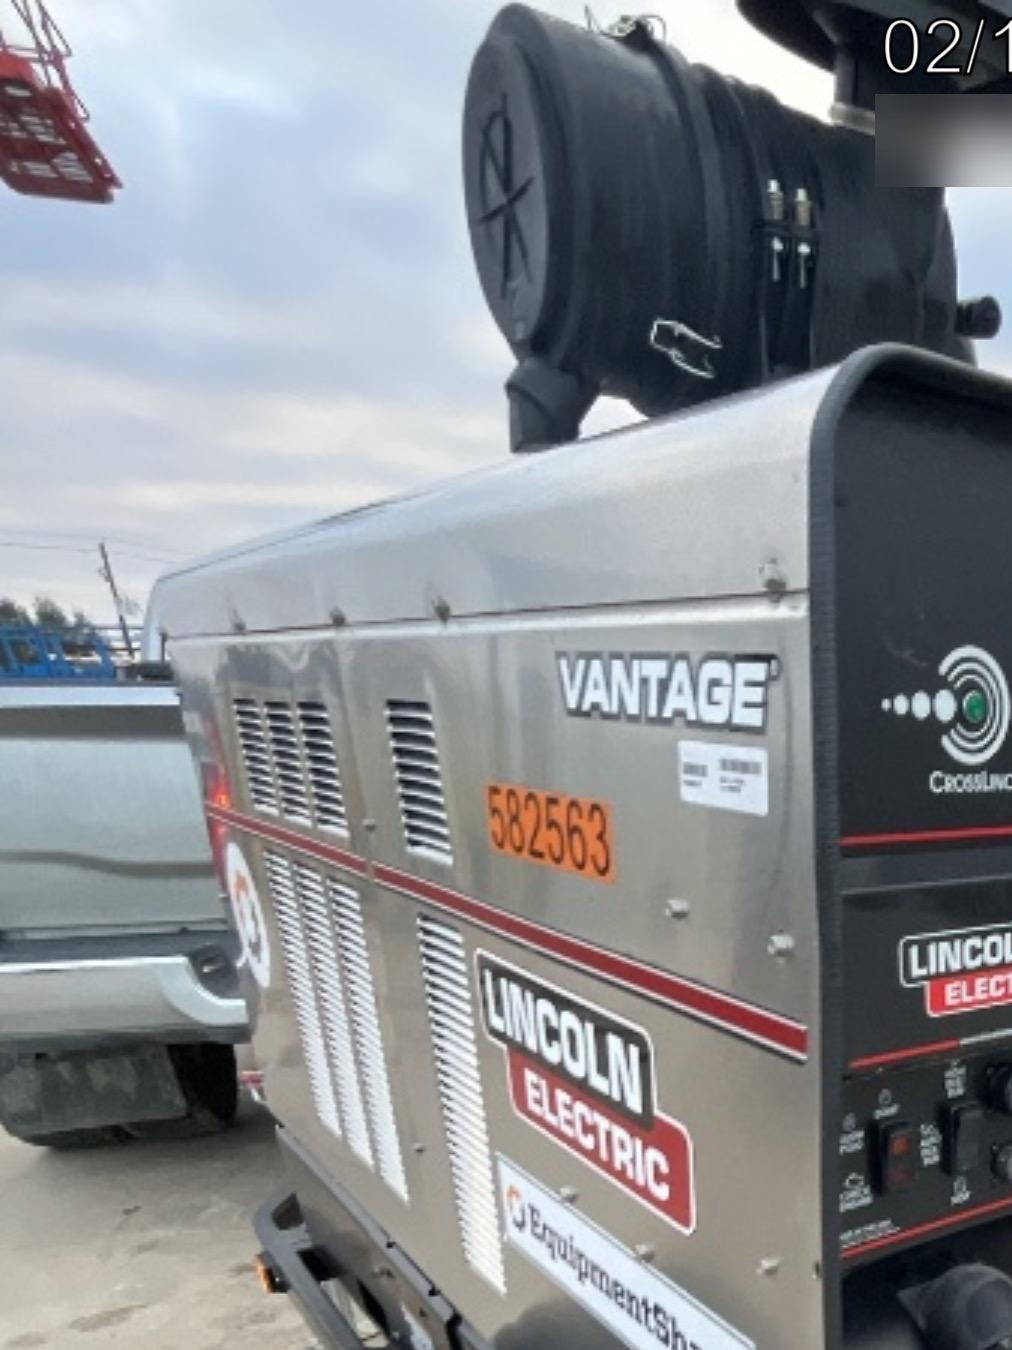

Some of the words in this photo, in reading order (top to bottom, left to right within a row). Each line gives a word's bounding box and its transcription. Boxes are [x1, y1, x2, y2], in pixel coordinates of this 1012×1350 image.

[558, 656, 770, 730] VANTAGE
[487, 786, 612, 879] 582563
[482, 968, 646, 1115] LINCOLN
[523, 1068, 672, 1203] ELECTRIC
